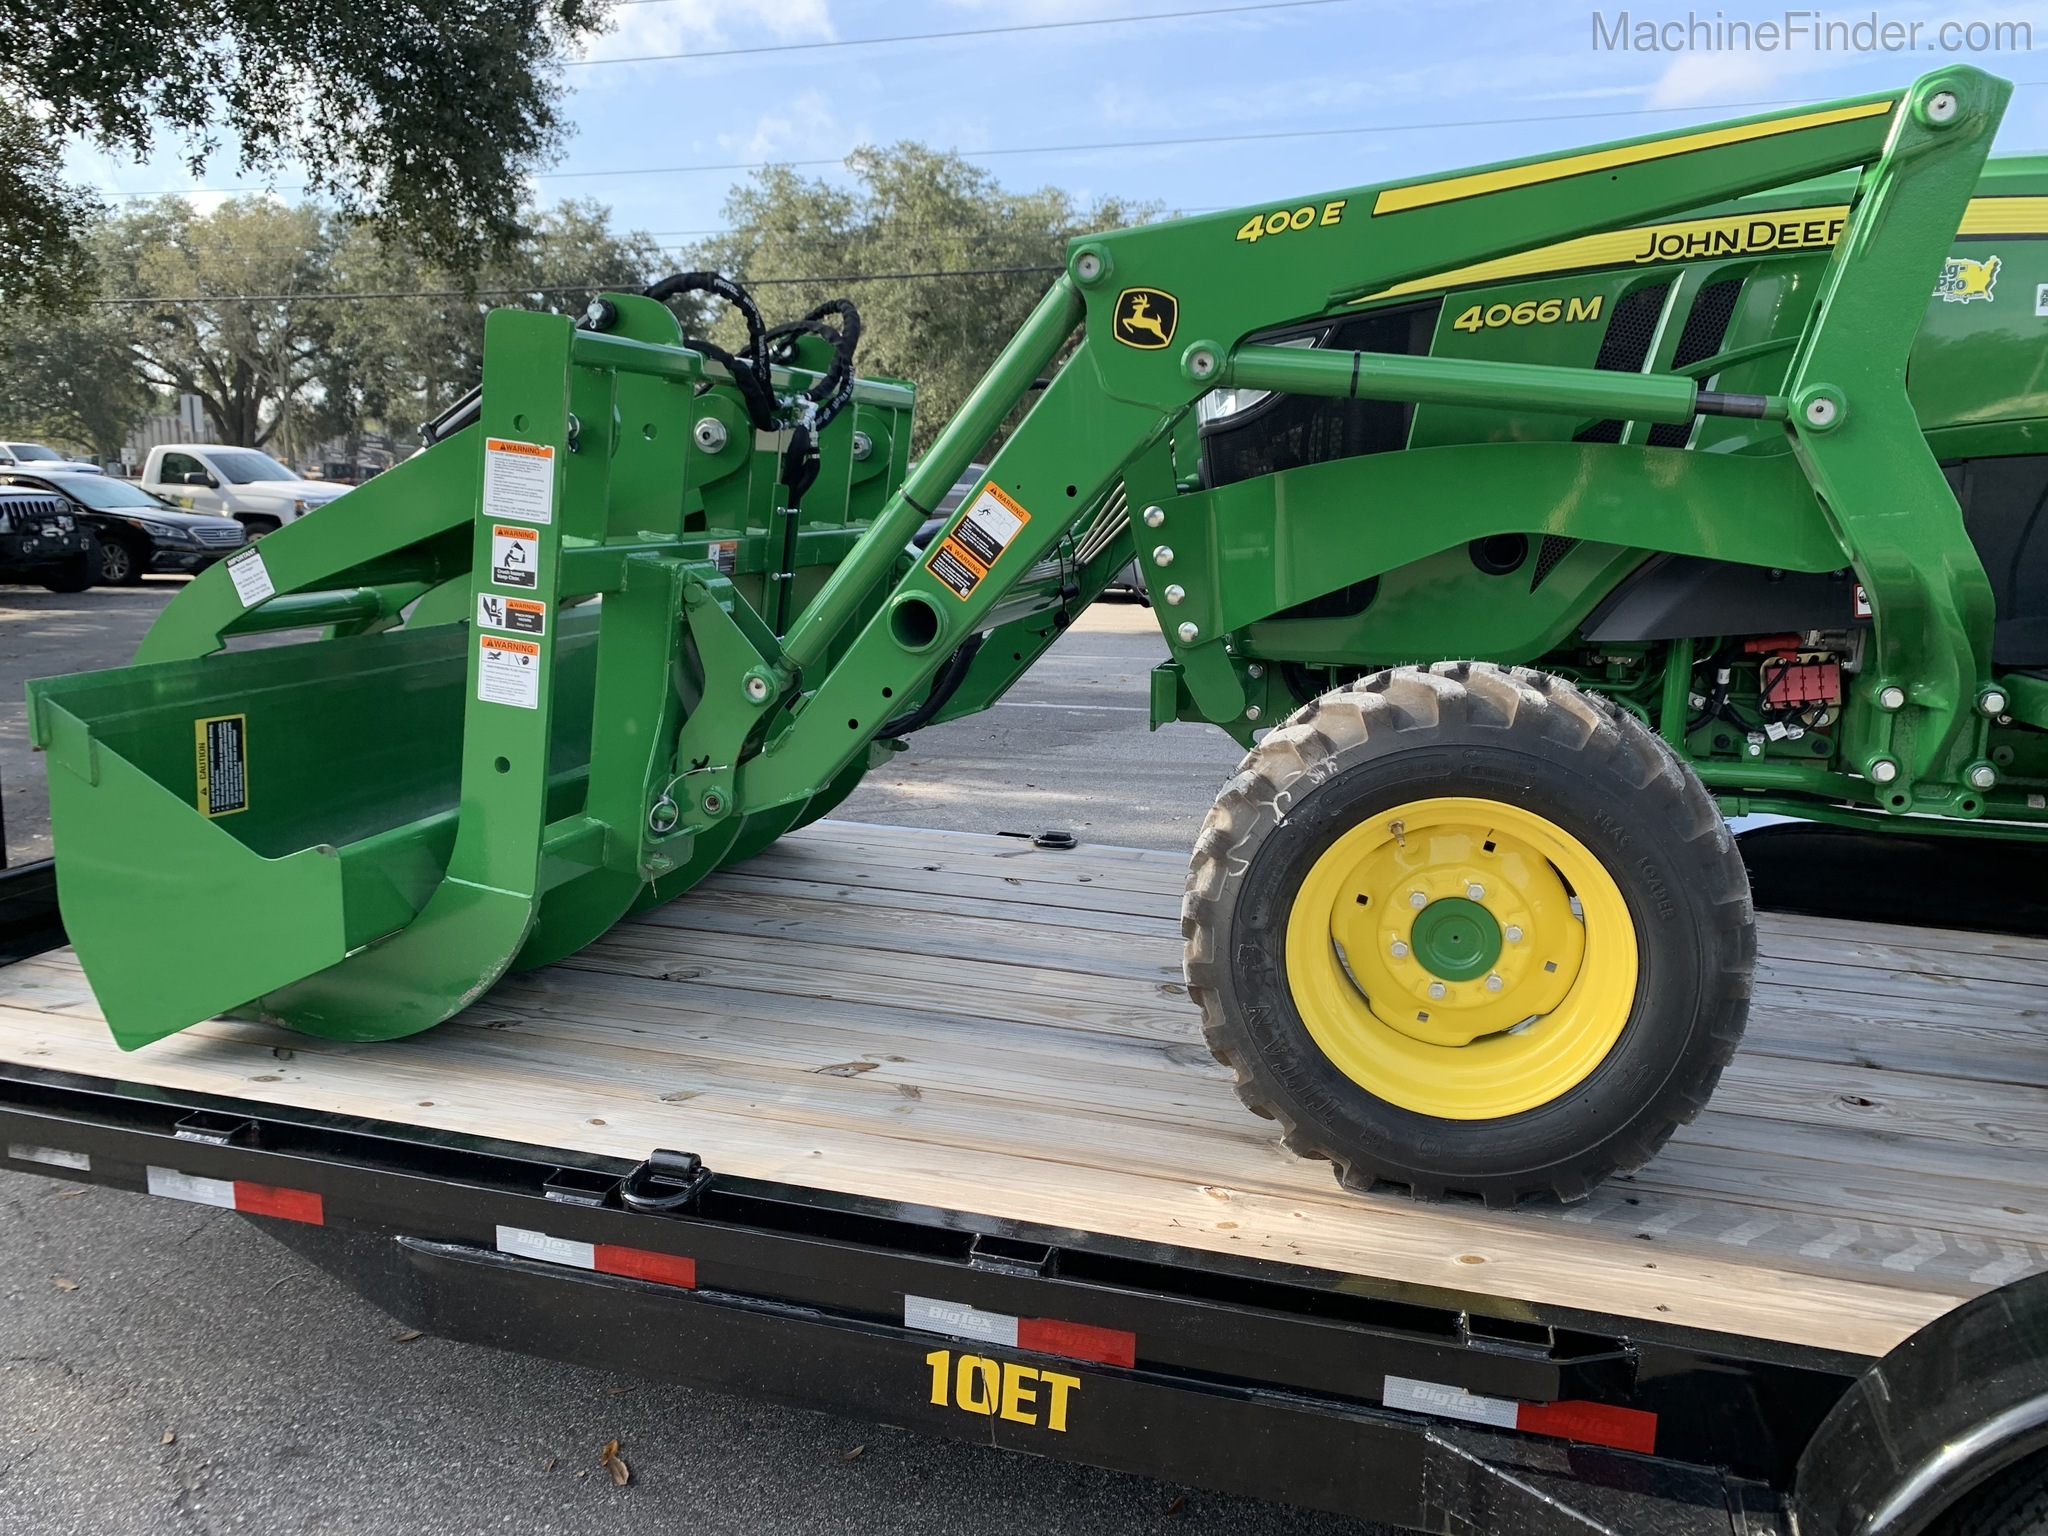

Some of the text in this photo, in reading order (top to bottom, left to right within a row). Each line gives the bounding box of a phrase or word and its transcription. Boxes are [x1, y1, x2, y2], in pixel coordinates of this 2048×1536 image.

[1636, 229, 1739, 259] JOHN
[505, 444, 540, 456] WARNING
[997, 492, 1025, 518] WARNING
[503, 528, 534, 539] WARNING
[954, 549, 981, 575] WARNING
[513, 602, 541, 611] WARNING
[494, 640, 534, 653] WARNING
[198, 742, 207, 780] CAUTION
[926, 1350, 1081, 1432] 10ET
